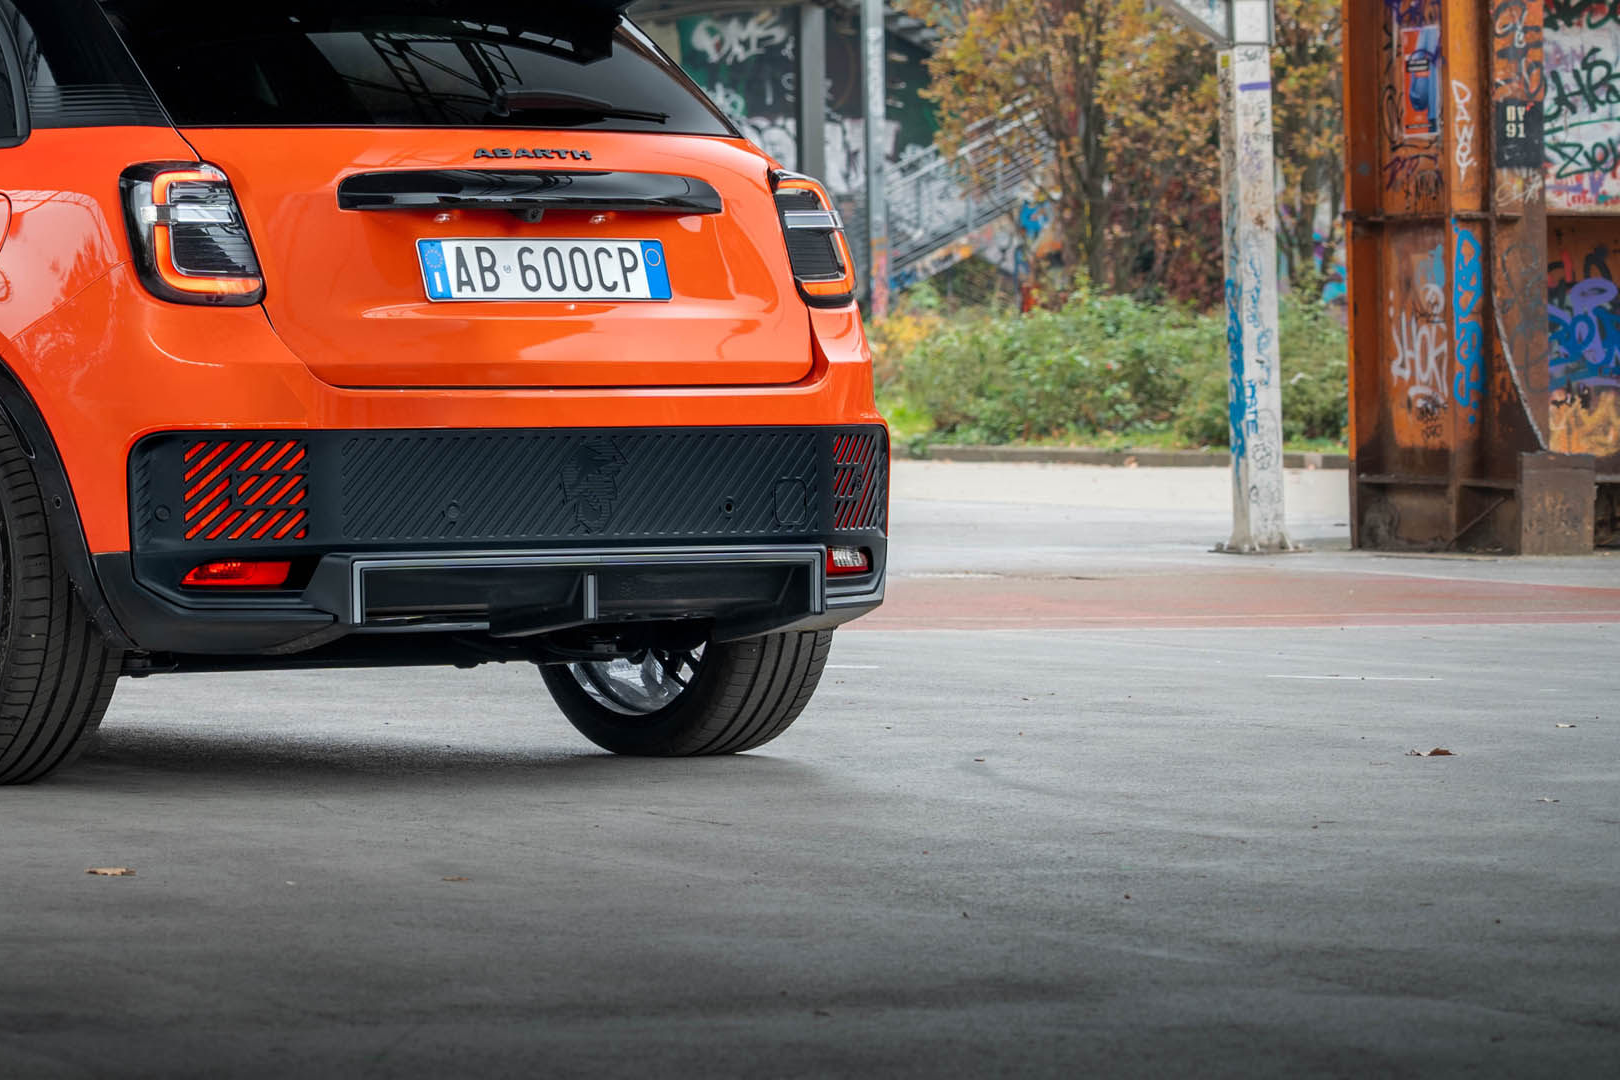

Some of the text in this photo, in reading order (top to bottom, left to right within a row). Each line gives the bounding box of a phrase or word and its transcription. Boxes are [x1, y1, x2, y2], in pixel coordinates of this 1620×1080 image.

[1506, 123, 1526, 138] 91
[473, 147, 593, 161] ABARTH
[455, 246, 501, 293] AB
[517, 246, 639, 293] 600CP
